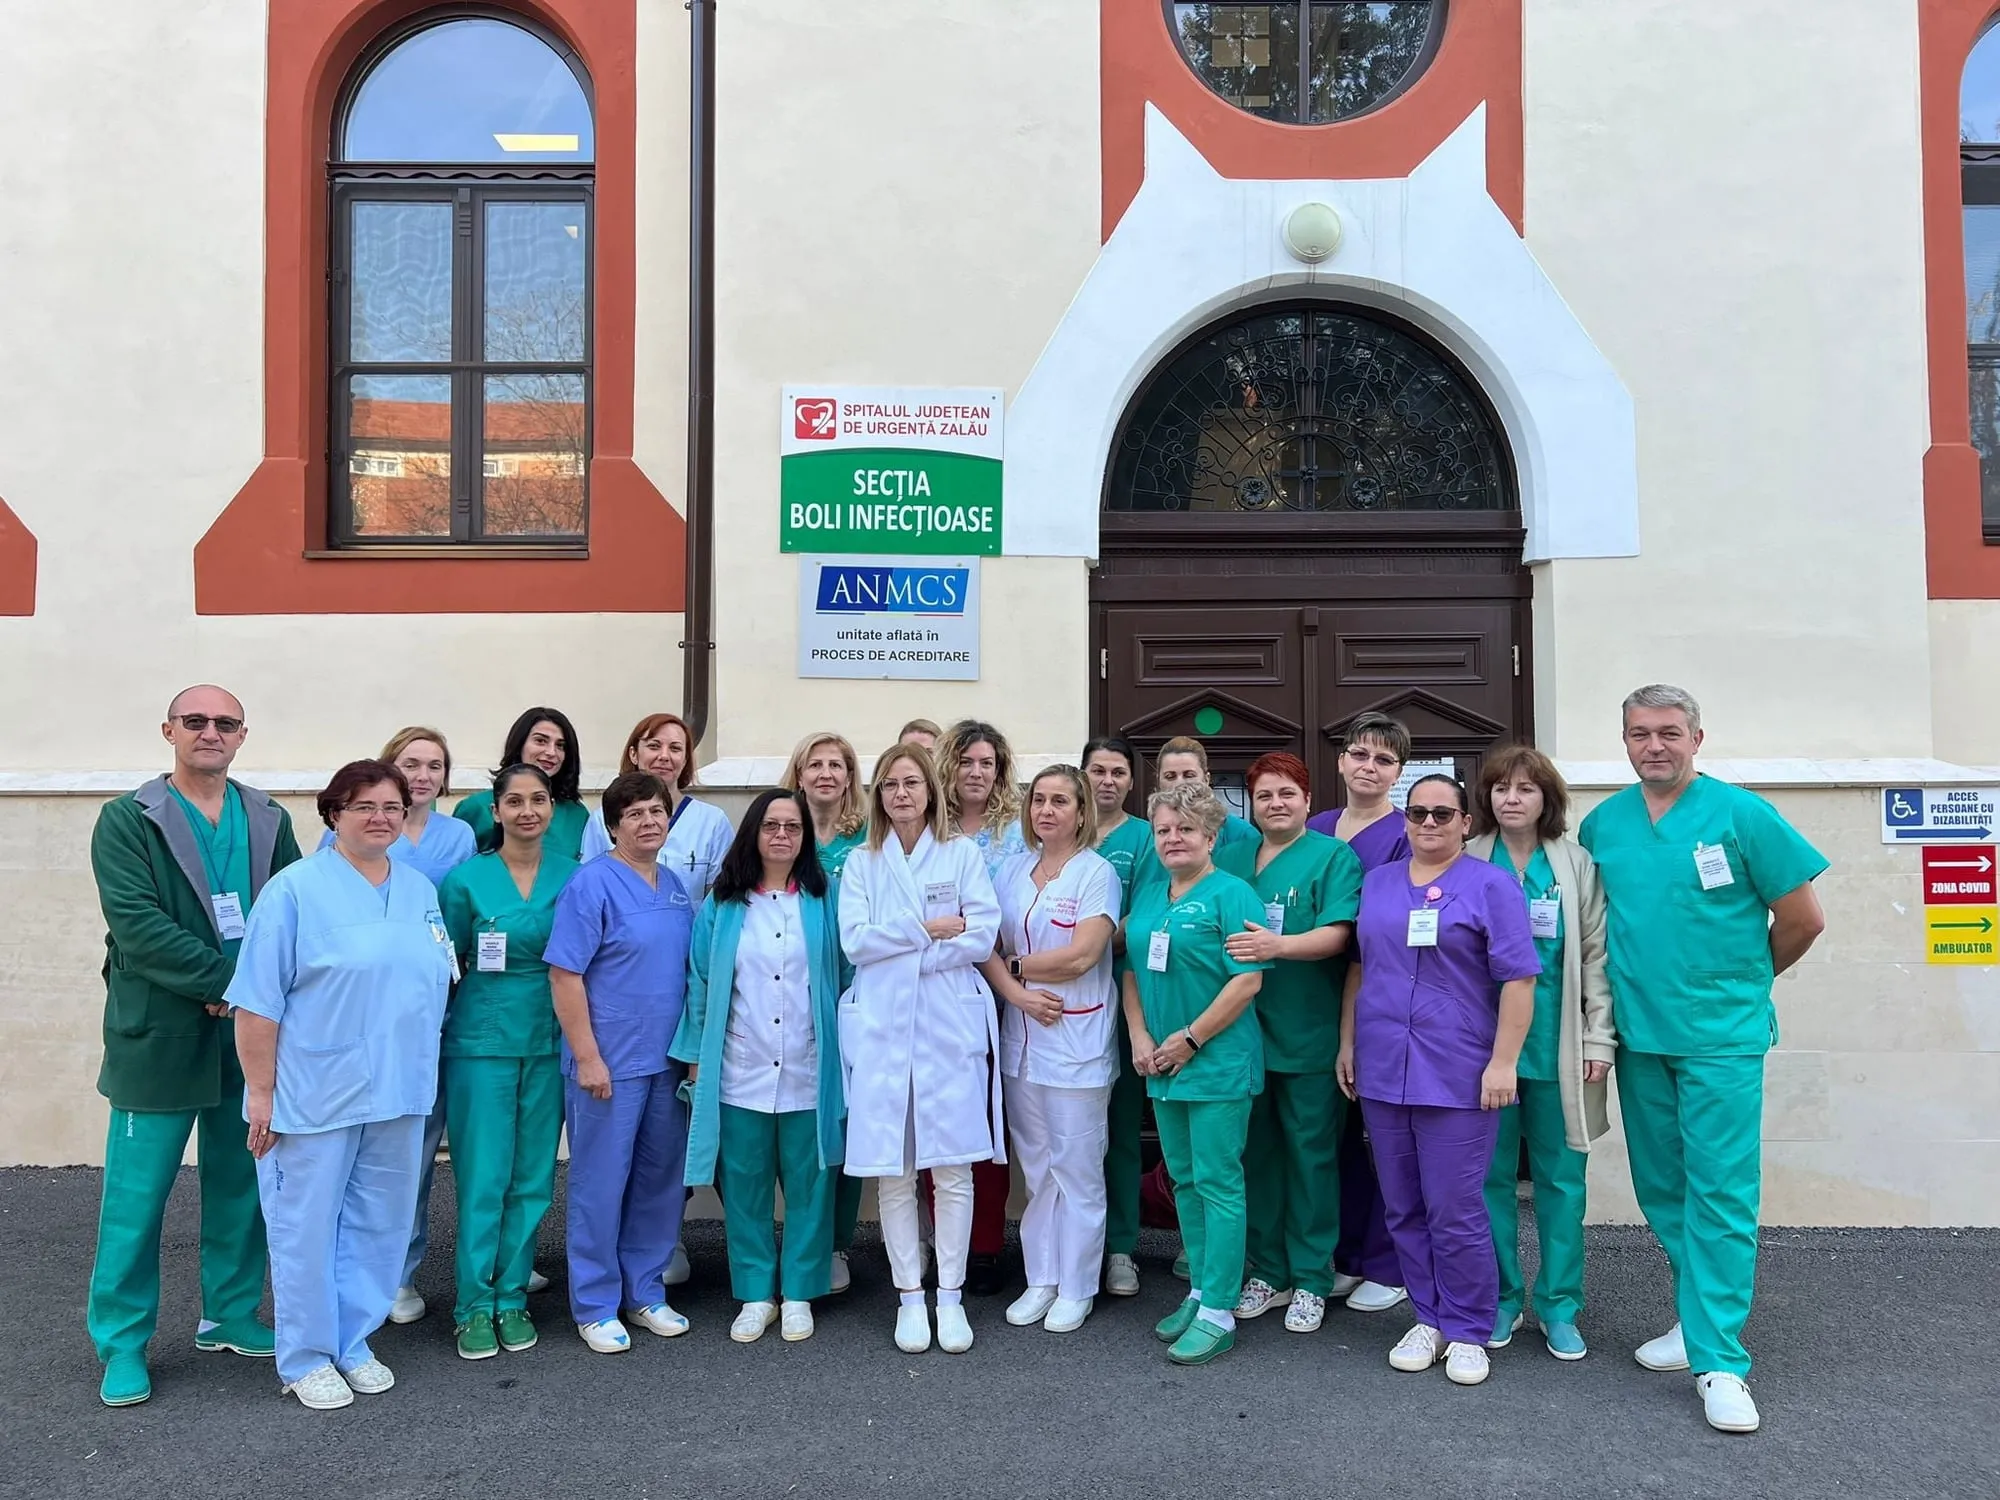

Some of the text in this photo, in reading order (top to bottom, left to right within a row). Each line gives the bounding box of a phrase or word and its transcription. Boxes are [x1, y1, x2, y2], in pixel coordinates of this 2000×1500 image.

[843, 404, 911, 417] SPITALUL
[843, 420, 987, 437] DE URGENȚĂ ZALĂU
[853, 469, 931, 501] SECȚIA
[790, 503, 993, 536] BOLI INFECȚIOASE
[830, 573, 956, 606] ANMCS
[836, 628, 939, 641] unitate aflată în
[811, 649, 970, 662] PROCES DE ACREDITARE
[1947, 792, 1979, 801] ACCES
[1930, 803, 1994, 813] PERSOANE CU
[1931, 882, 1990, 894] ZONA COVID
[1933, 943, 1993, 954] AMBULATOR
